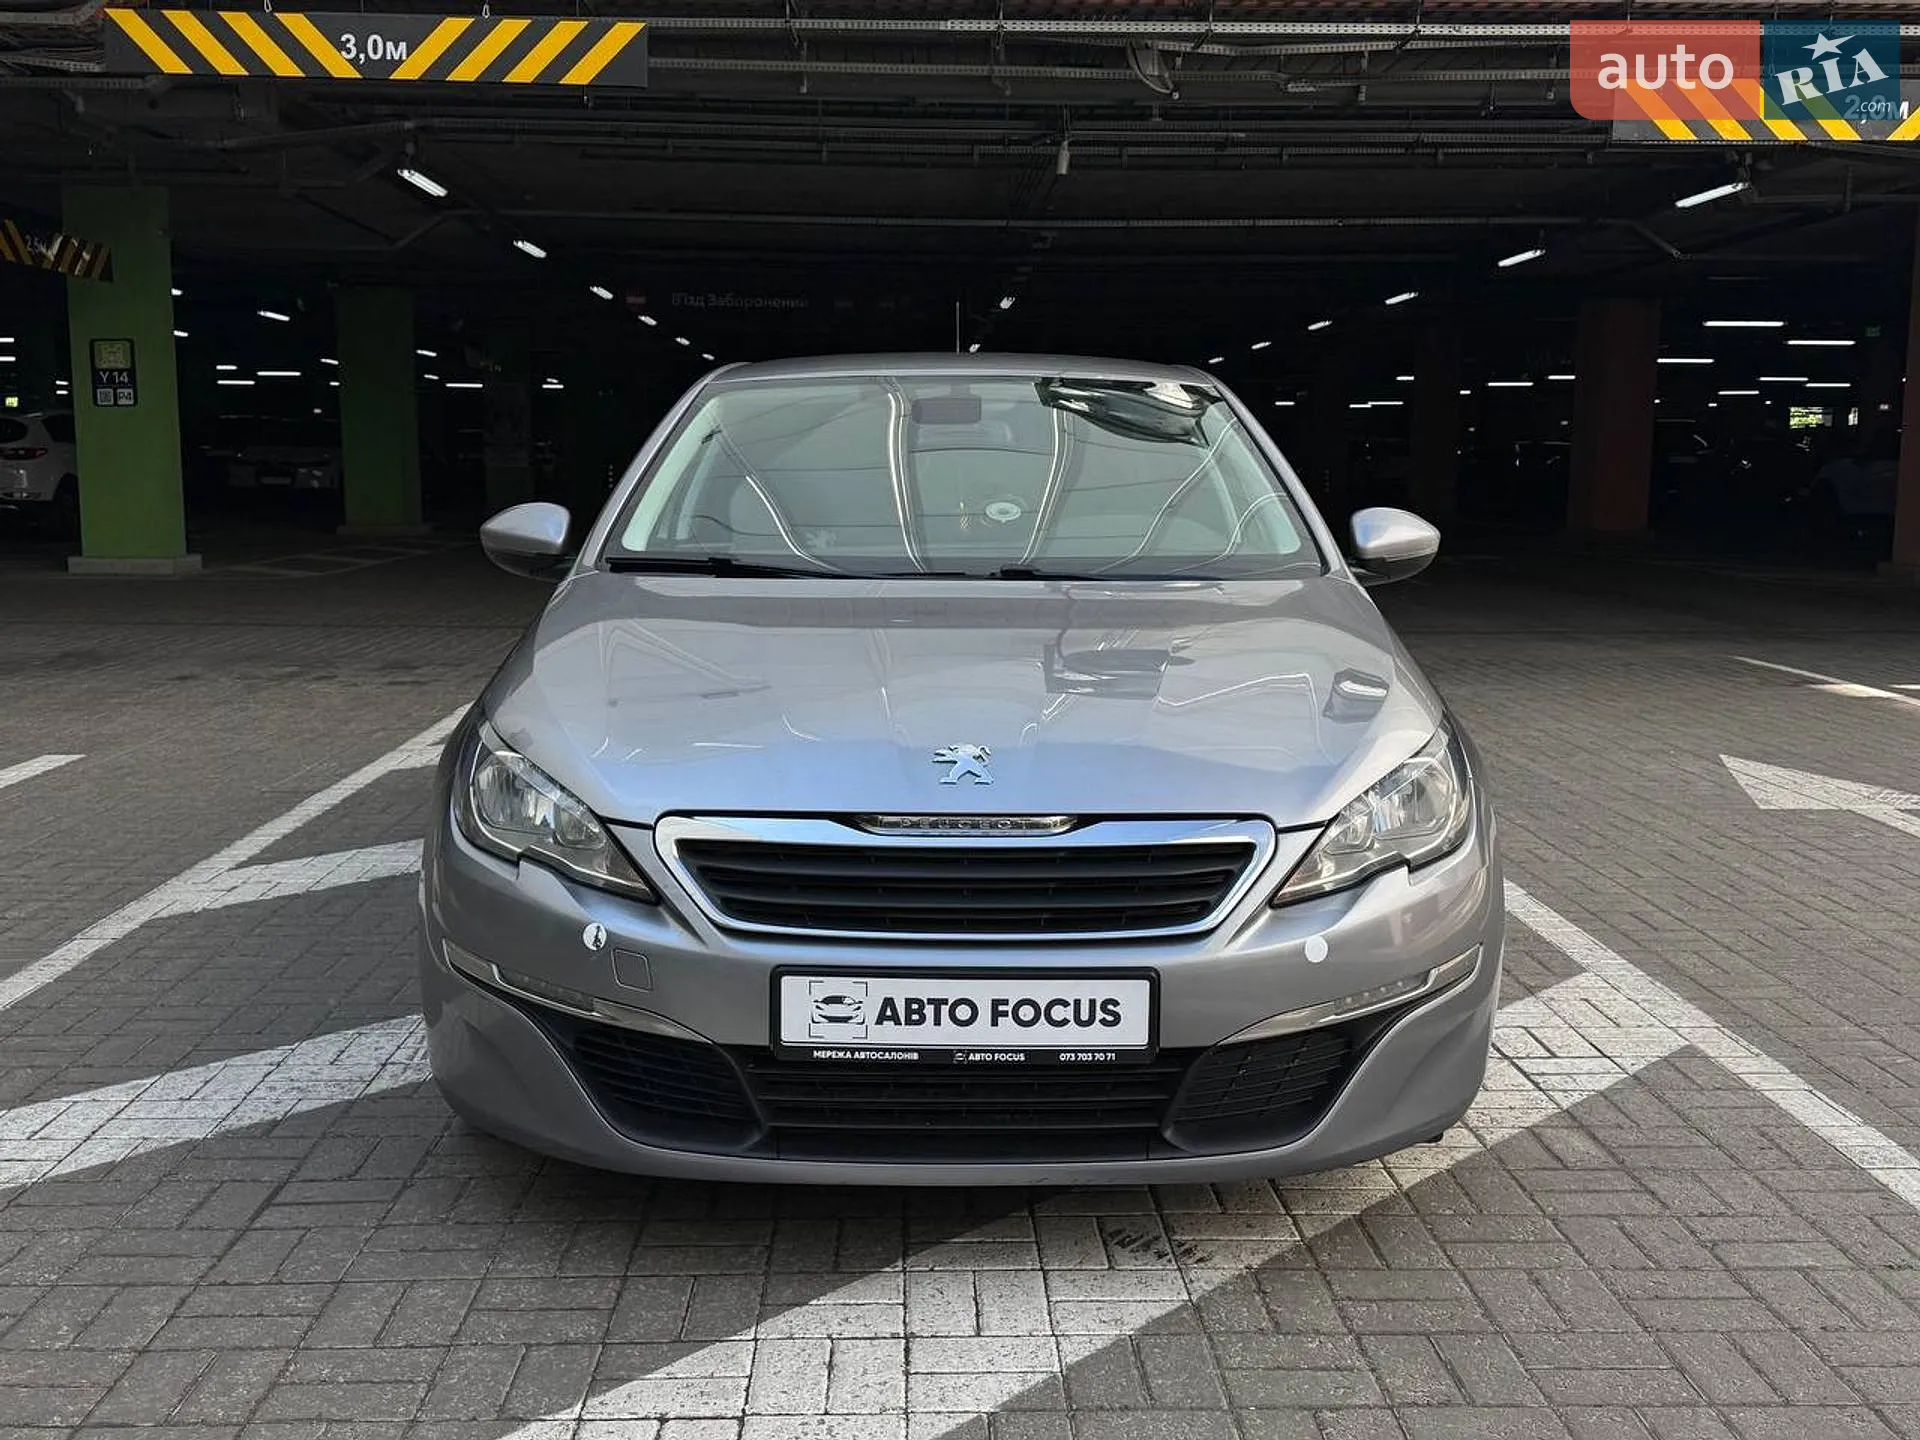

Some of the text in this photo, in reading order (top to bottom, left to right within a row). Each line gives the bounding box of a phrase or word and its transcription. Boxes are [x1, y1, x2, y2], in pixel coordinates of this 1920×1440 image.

[340, 33, 407, 64] 3,0м
[112, 371, 129, 384] 14
[875, 996, 1122, 1028] АВТО FOCUS
[812, 1050, 919, 1060] МЕРЕЖА АВТОСАЛОНІВ
[967, 1053, 1026, 1061] АВТО FOCUS
[1059, 1053, 1116, 1061] 073 703 70 71
